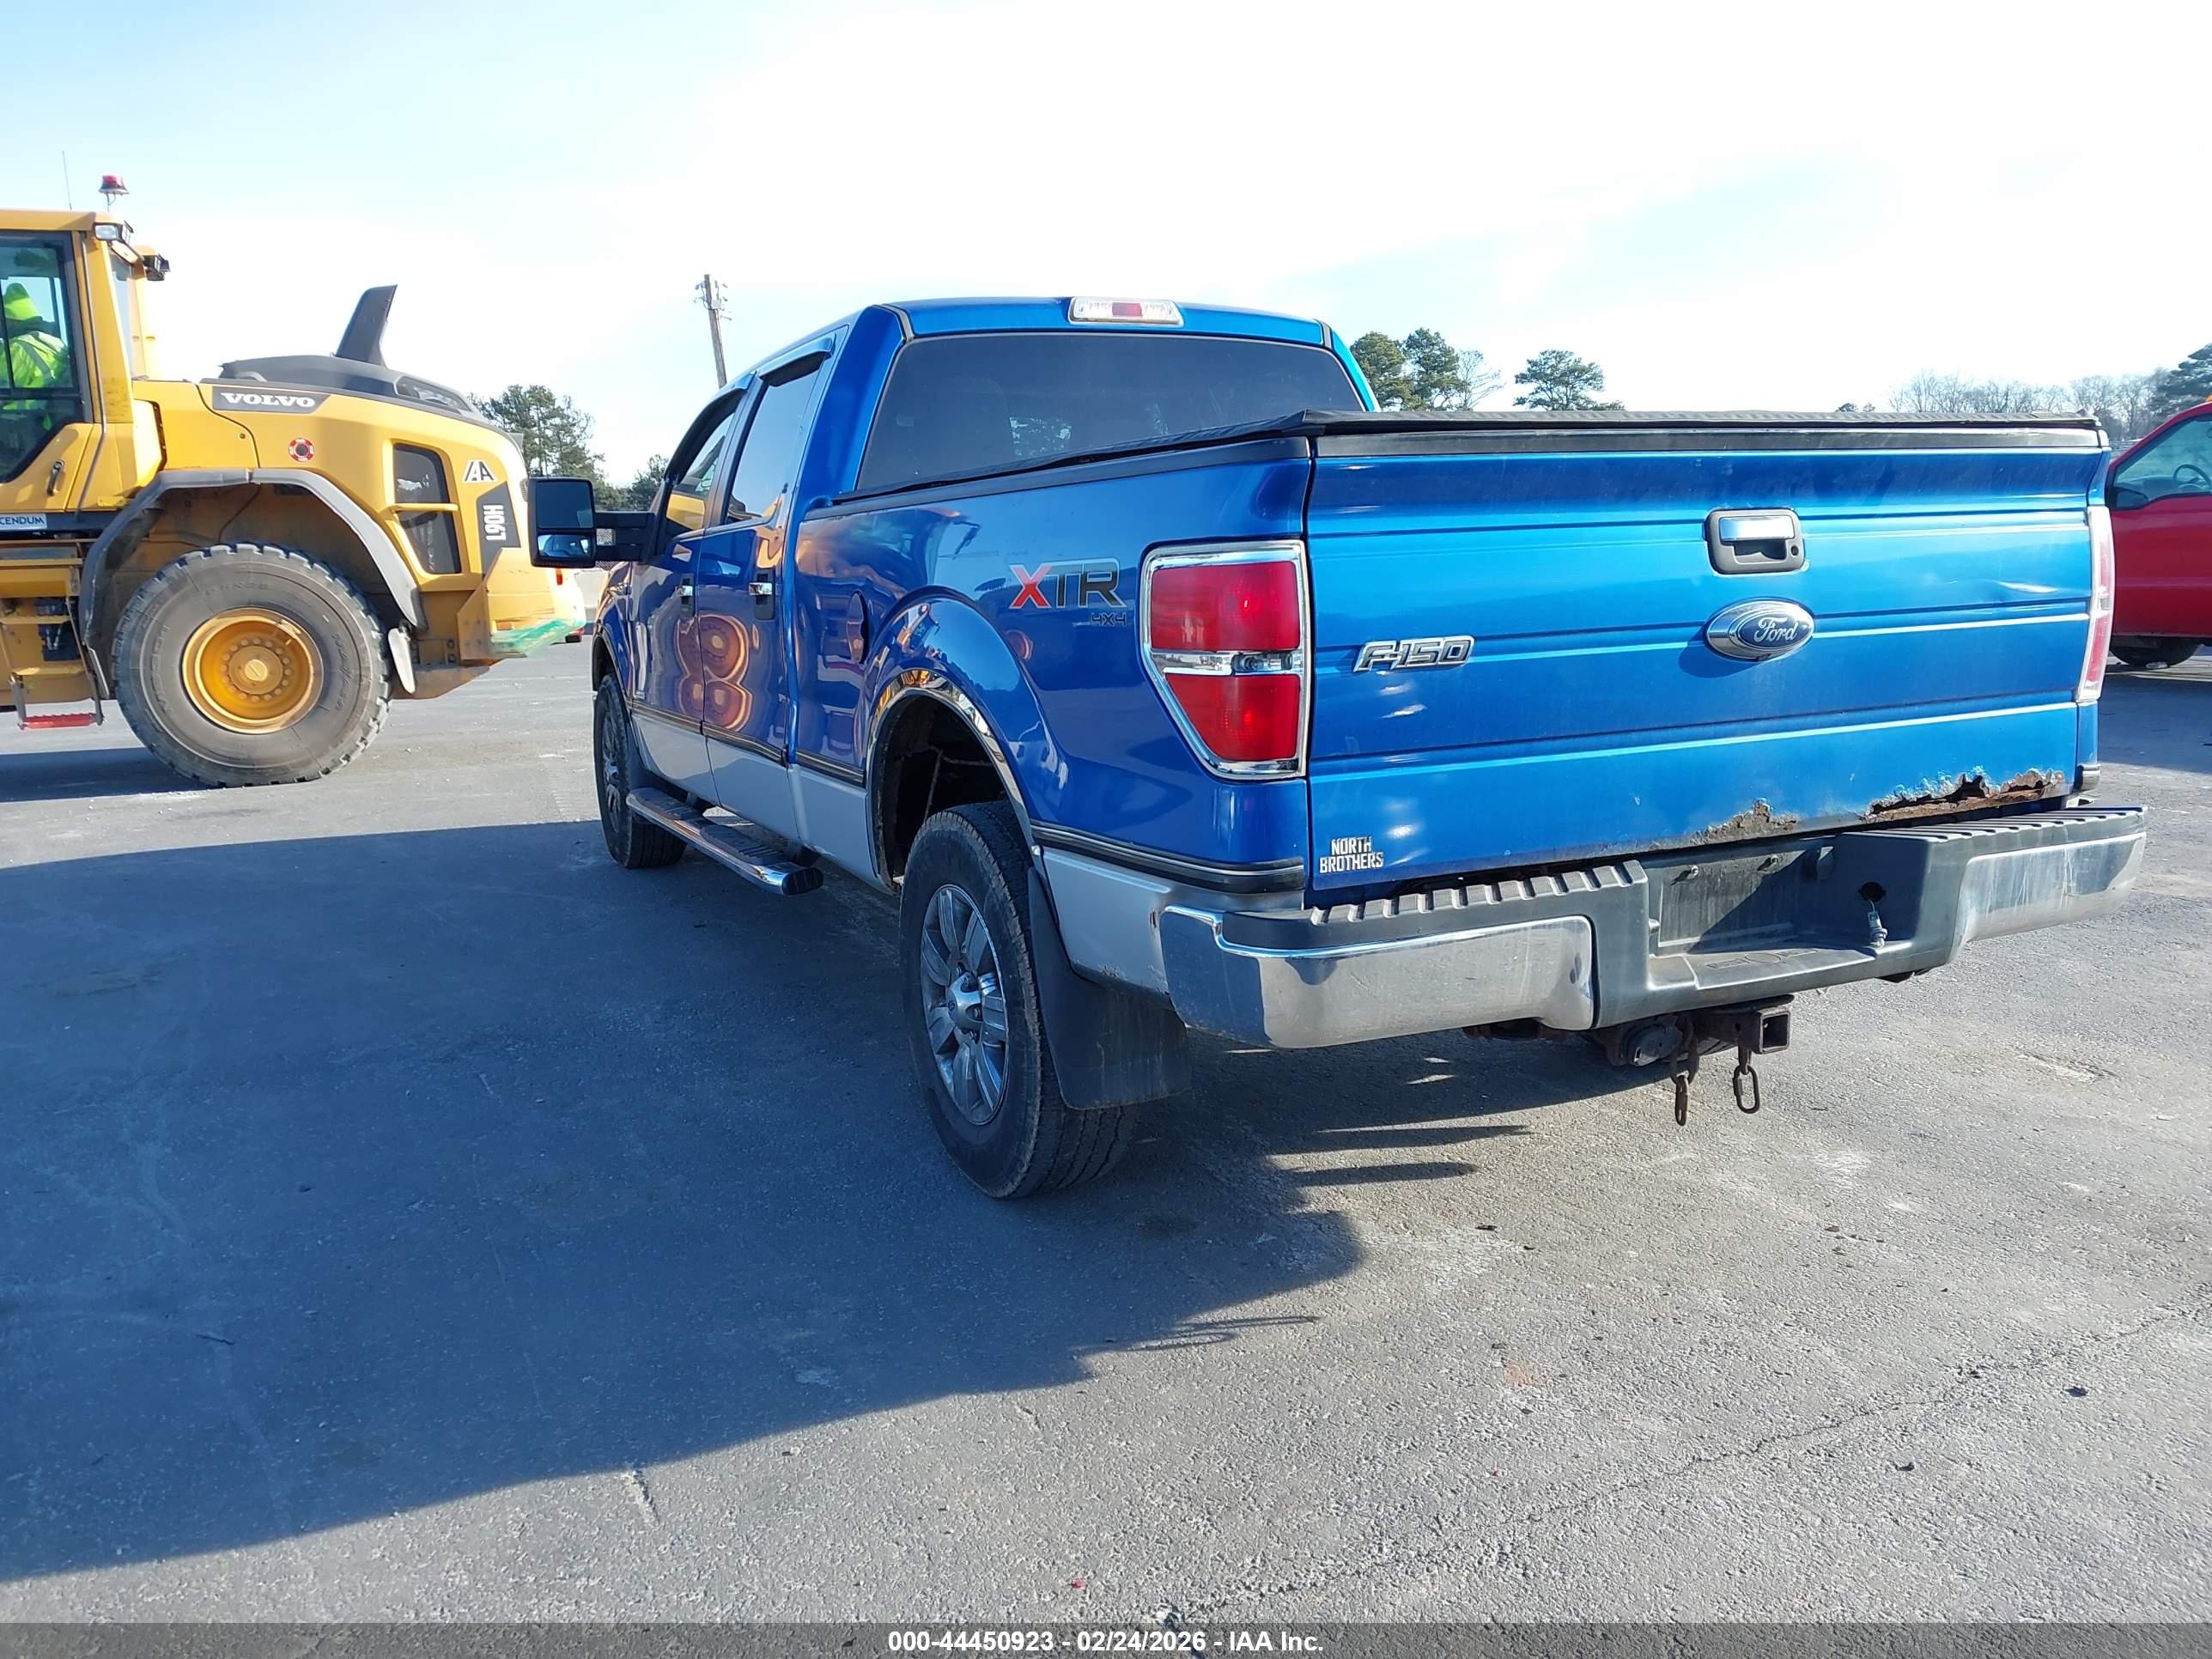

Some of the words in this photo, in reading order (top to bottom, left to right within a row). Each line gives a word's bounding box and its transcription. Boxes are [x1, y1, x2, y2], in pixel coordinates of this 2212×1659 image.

[220, 392, 316, 408] VOLVO
[483, 504, 507, 541] L90H
[1008, 558, 1127, 609] XTR
[1753, 617, 1800, 642] Ford
[1353, 635, 1475, 672] F-150
[1331, 836, 1372, 855] NORTH
[1319, 852, 1384, 873] BROTHERS
